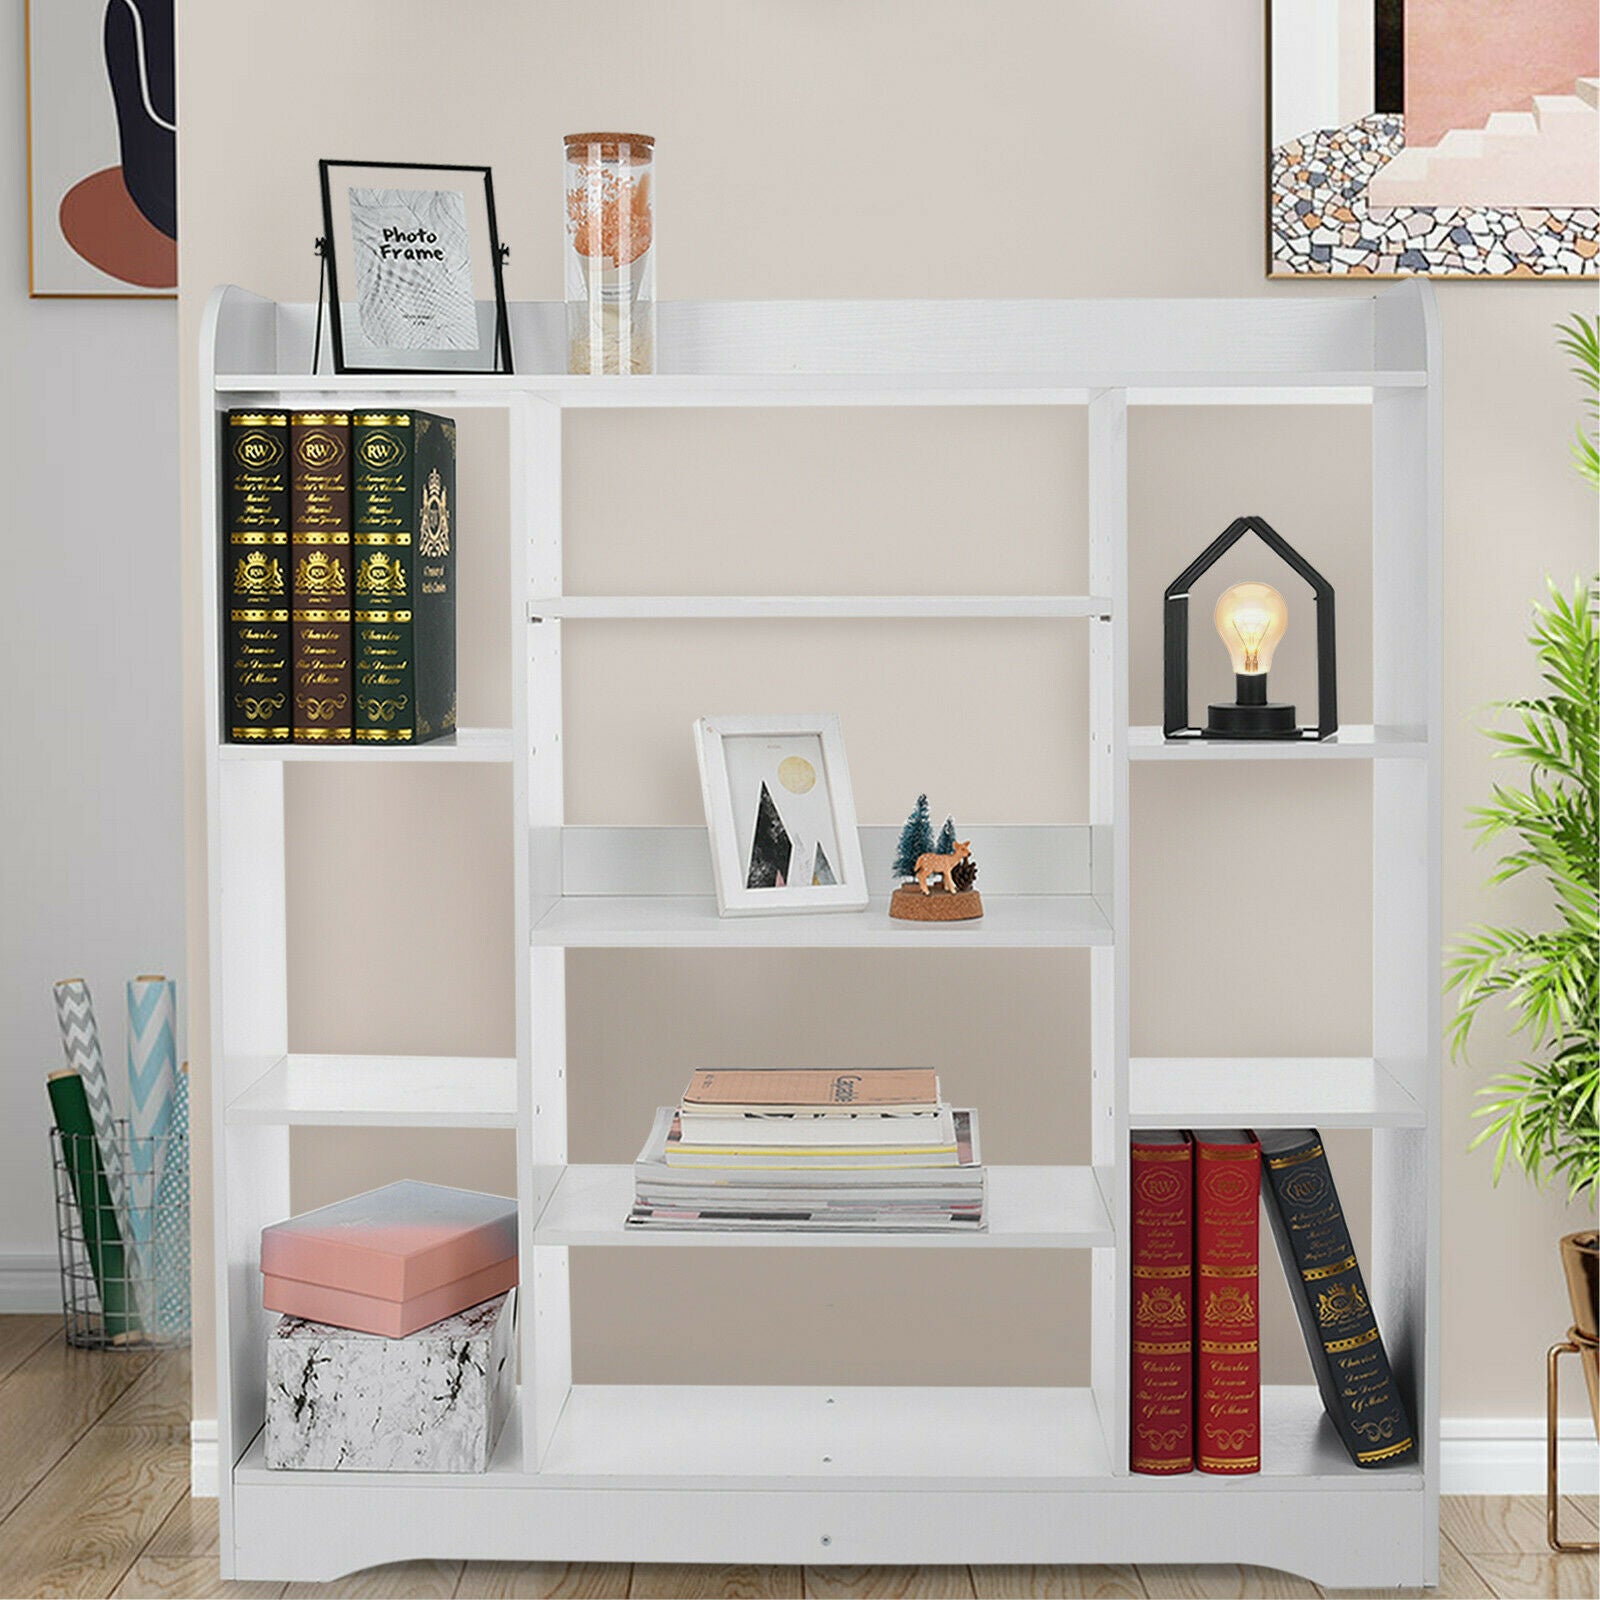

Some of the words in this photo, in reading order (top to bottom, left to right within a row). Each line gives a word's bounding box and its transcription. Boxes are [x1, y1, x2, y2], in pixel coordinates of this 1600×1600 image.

[383, 226, 437, 243] Photo
[380, 244, 444, 261] Frame
[245, 444, 269, 459] RW
[306, 444, 331, 459] RW
[367, 444, 392, 459] RW
[1150, 1180, 1175, 1194] RW
